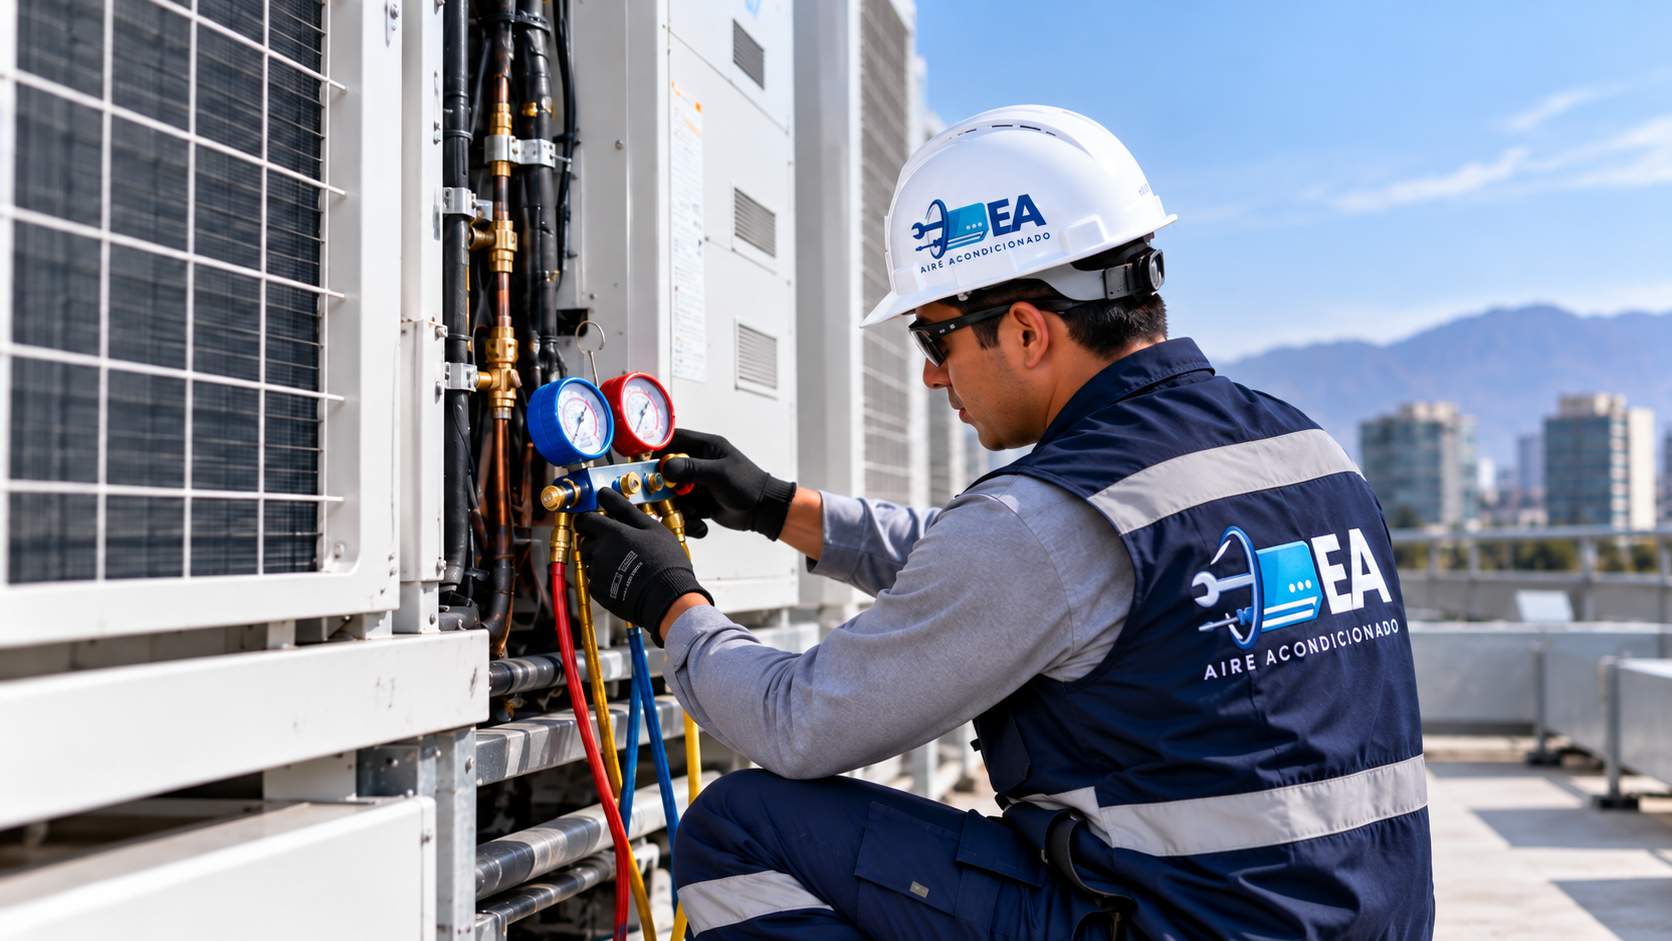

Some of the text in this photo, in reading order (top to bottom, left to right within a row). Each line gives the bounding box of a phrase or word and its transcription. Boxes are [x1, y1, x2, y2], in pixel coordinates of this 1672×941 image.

[987, 193, 1046, 237] EA
[920, 232, 1051, 274] AIRE ACONDICIONADO
[1311, 527, 1392, 615] EA
[1204, 618, 1399, 681] AIRE ACONDICIONADO
